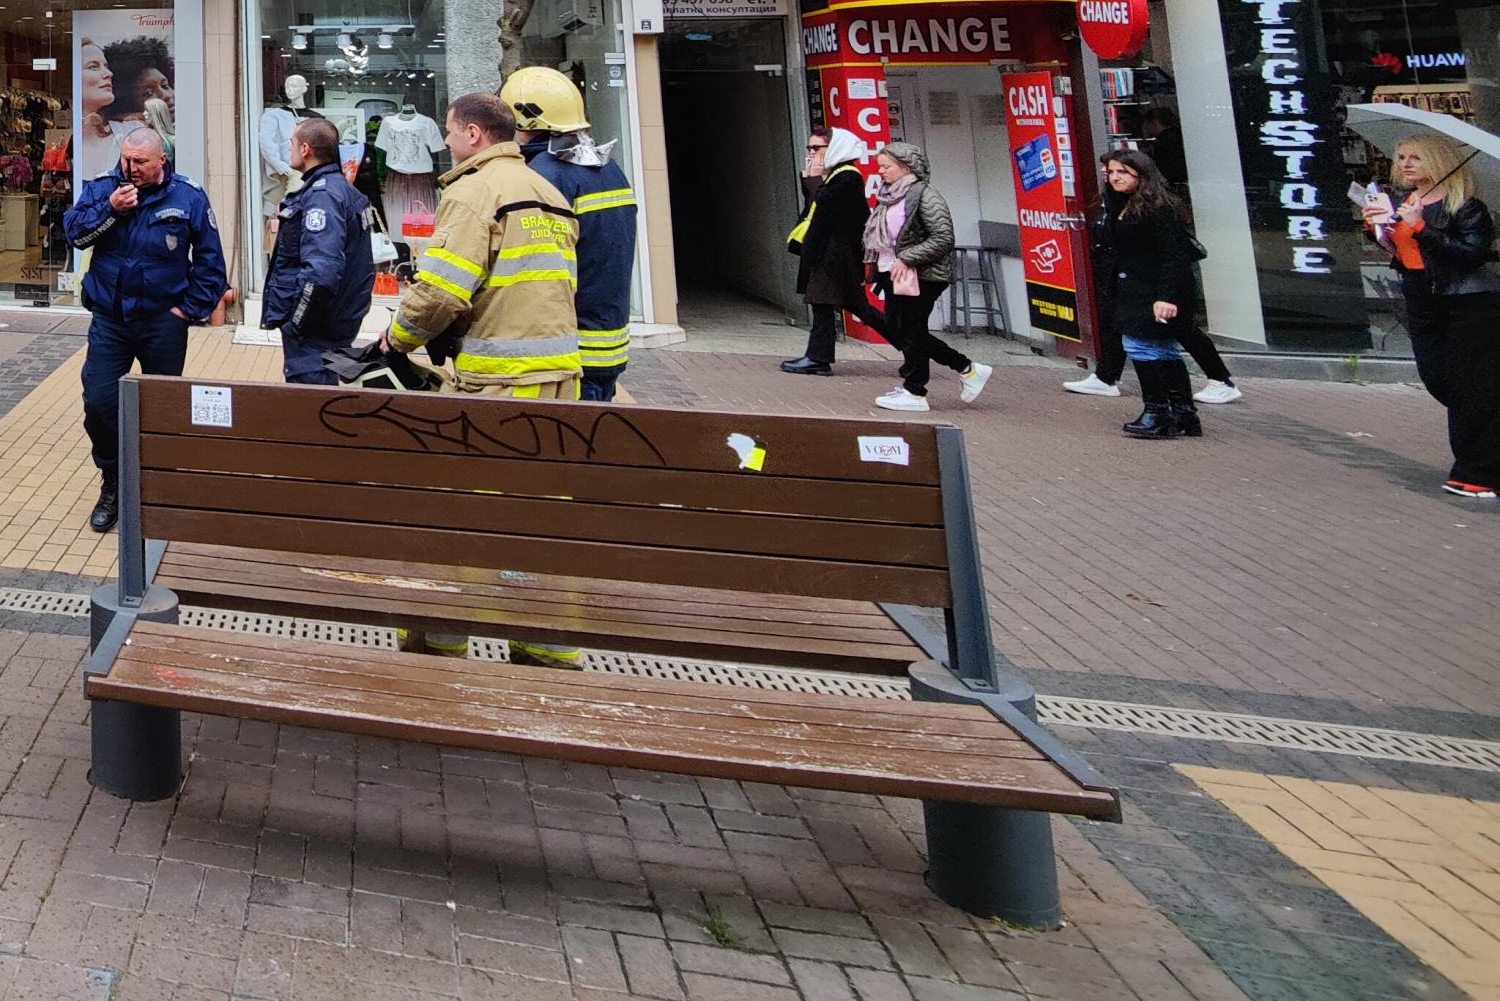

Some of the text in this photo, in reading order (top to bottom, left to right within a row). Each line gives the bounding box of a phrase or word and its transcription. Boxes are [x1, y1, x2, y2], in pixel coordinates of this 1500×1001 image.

[706, 6, 776, 16] консултация
[1080, 0, 1129, 24] CHANGE
[804, 23, 838, 55] CHANGE
[848, 17, 1011, 54] CHANGE
[1406, 52, 1466, 68] HUAW
[1009, 86, 1048, 116] CASH
[1020, 208, 1066, 232] CHANGE
